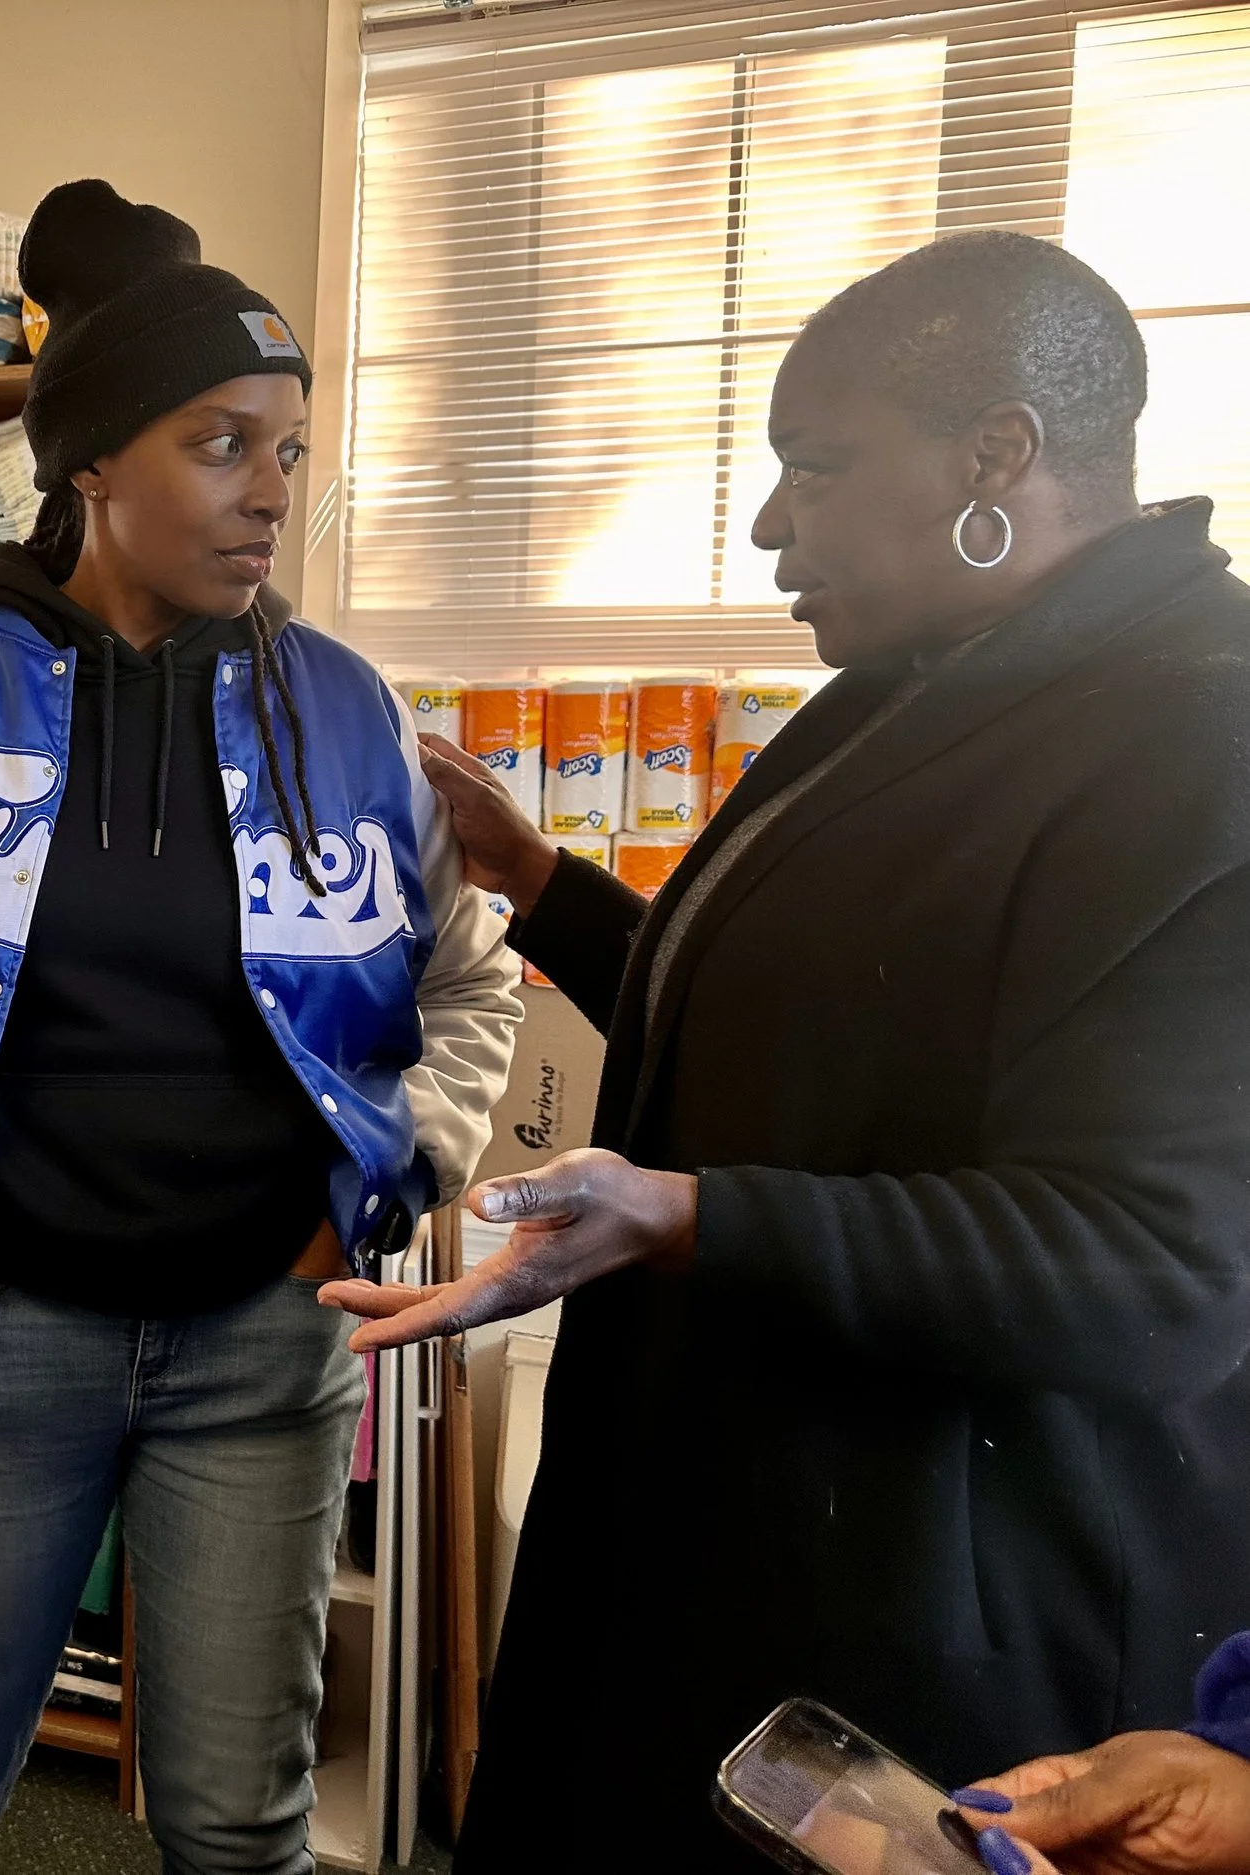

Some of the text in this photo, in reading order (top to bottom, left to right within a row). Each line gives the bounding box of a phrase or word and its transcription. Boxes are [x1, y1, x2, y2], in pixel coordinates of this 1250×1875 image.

[742, 694, 760, 714] 4
[564, 753, 599, 777] Scott
[650, 745, 688, 769] Scott
[588, 810, 605, 829] 4
[675, 803, 693, 823] 4
